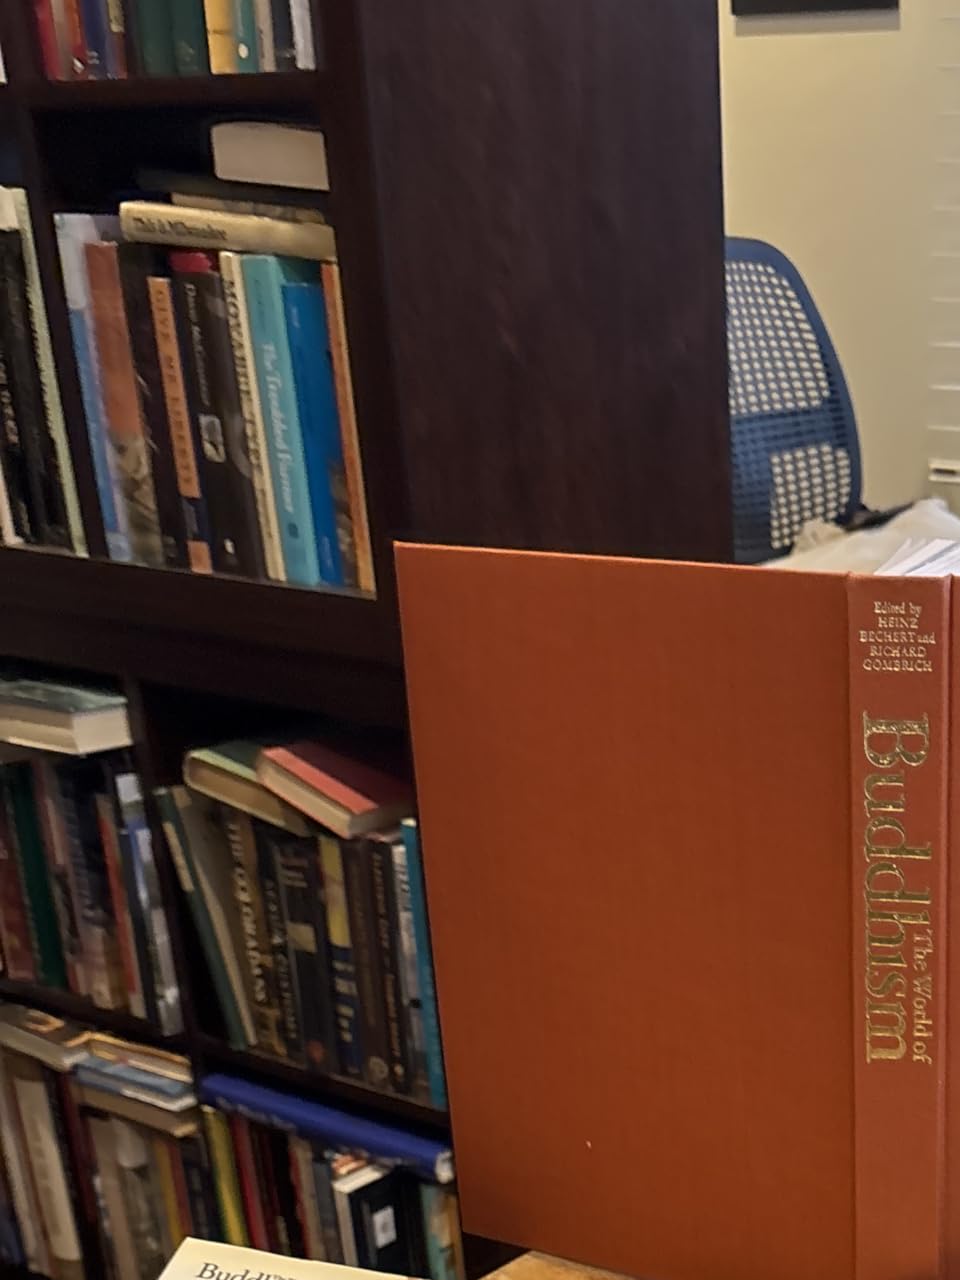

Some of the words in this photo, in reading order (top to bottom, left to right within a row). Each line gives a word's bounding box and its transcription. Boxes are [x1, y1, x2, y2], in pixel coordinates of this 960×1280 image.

[874, 601, 905, 614] Edited
[909, 602, 922, 618] by
[878, 617, 919, 629] HEINZ
[859, 630, 916, 643] BECHERT
[870, 646, 927, 658] RICHARD
[863, 659, 932, 672] GOMBRICH
[863, 710, 932, 1064] Buddhism
[913, 929, 934, 972] The
[913, 975, 933, 1039] World
[913, 1041, 932, 1065] of
